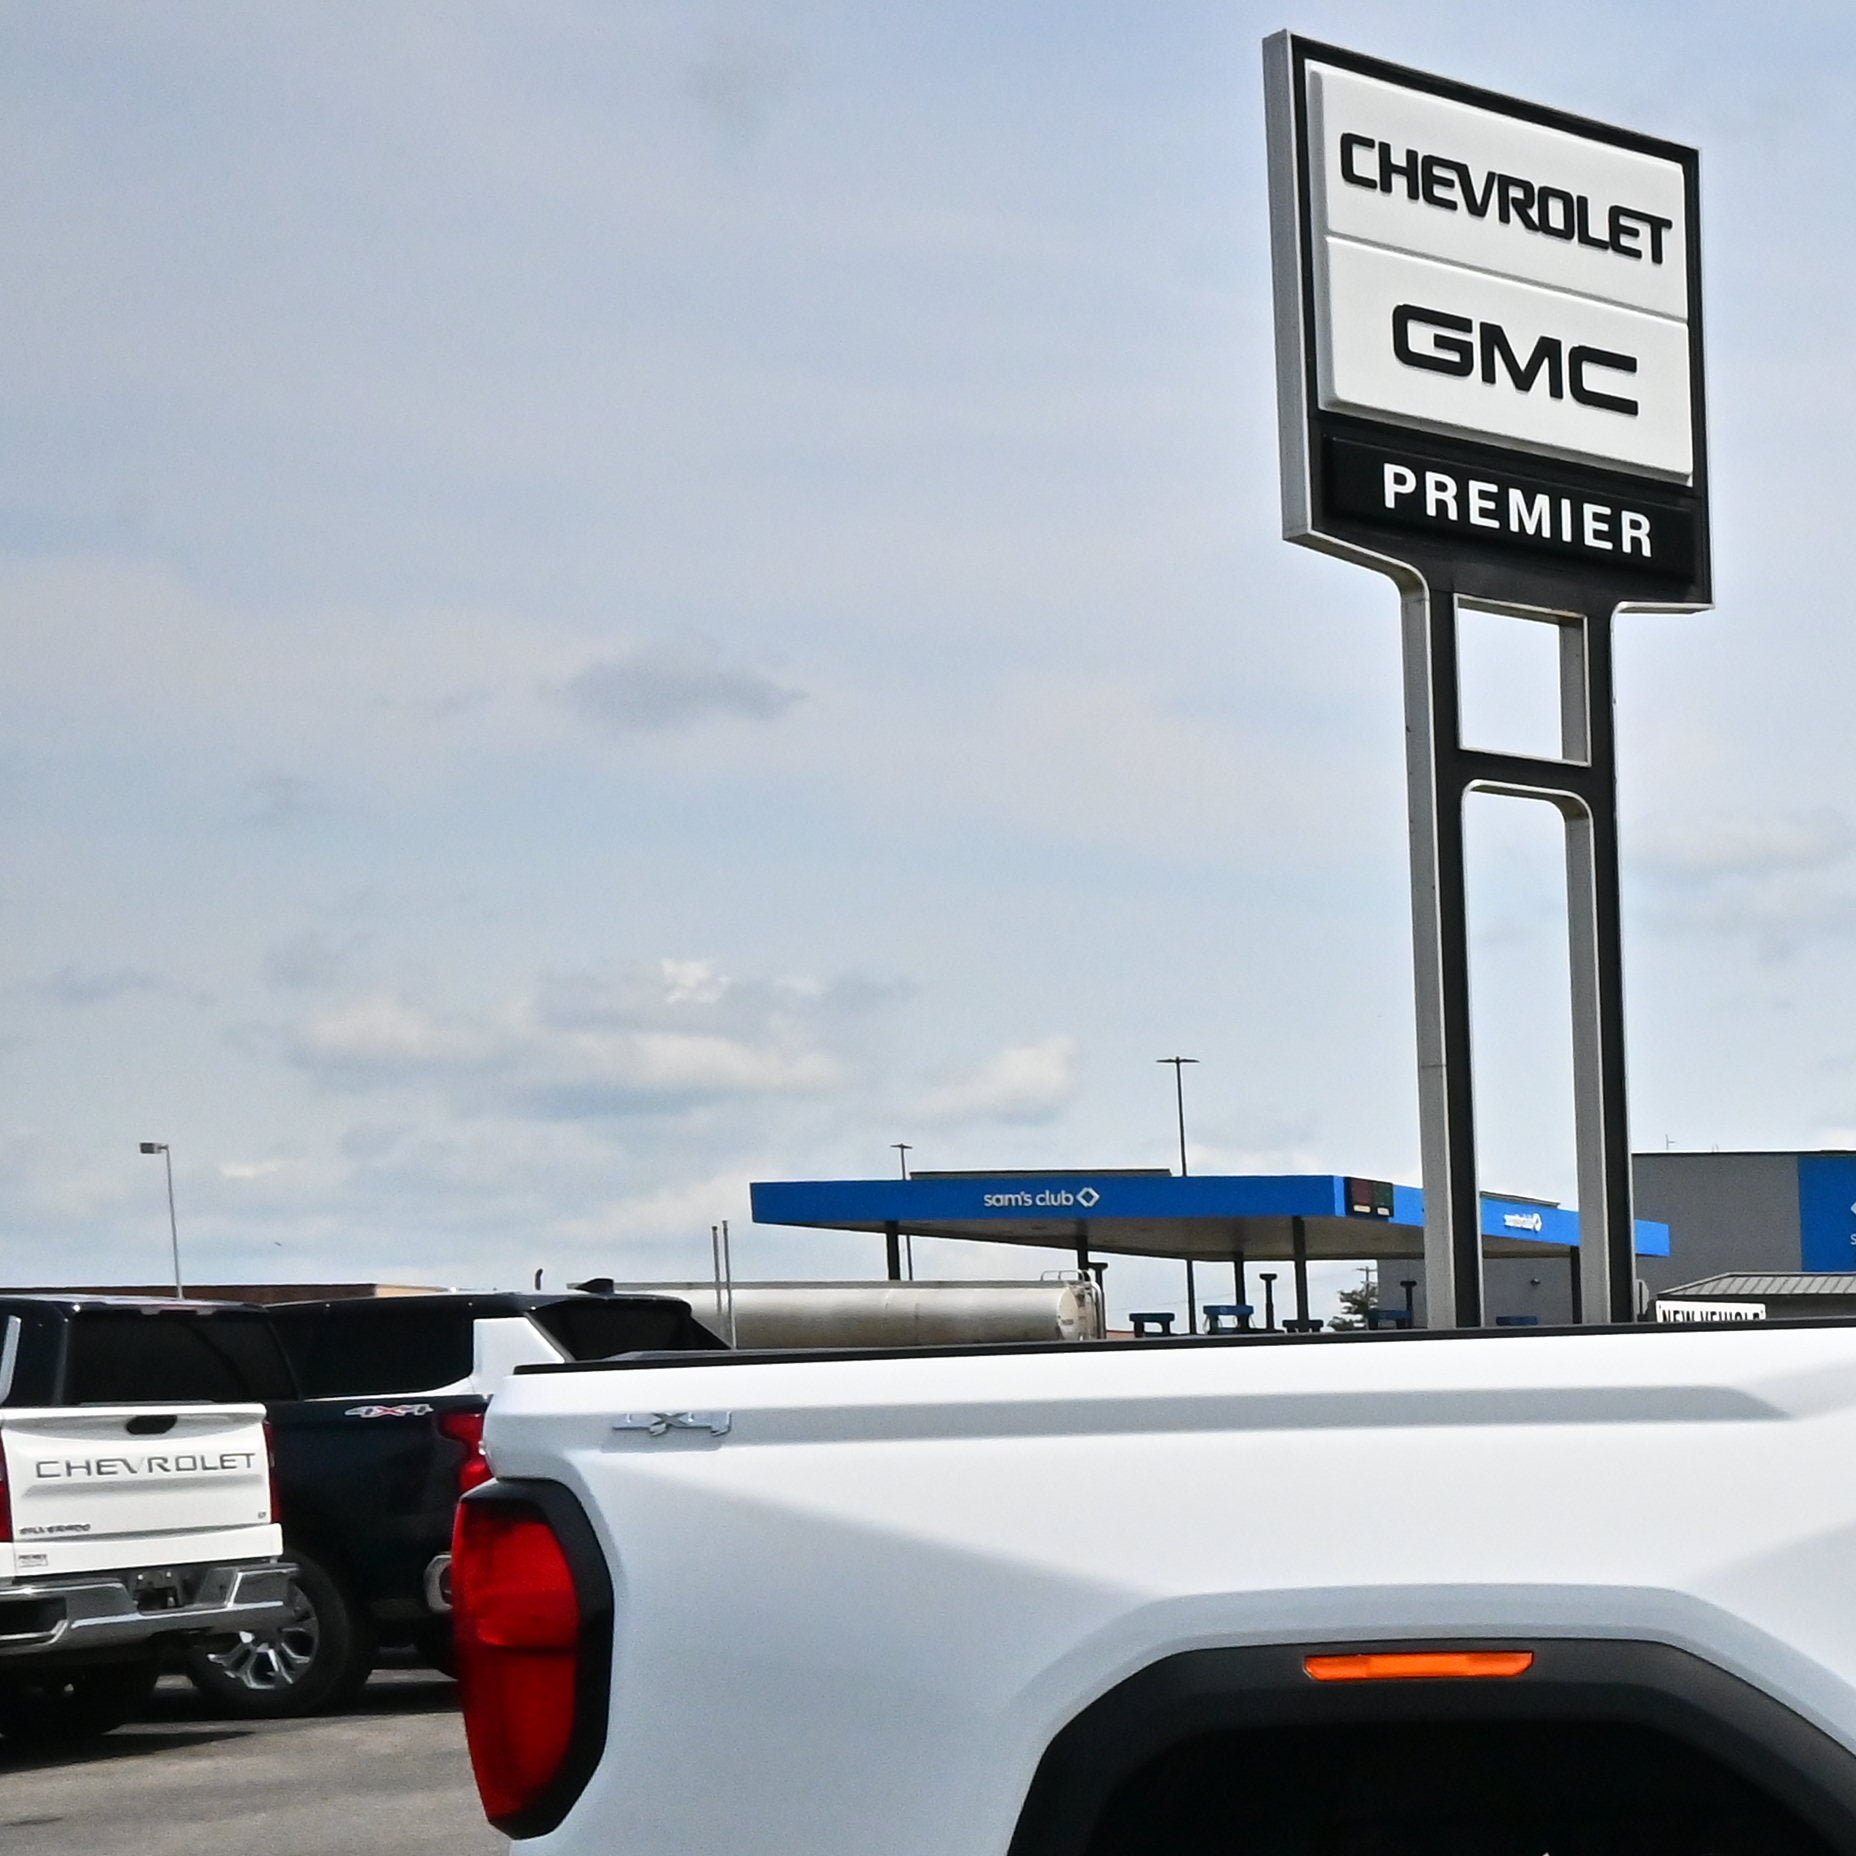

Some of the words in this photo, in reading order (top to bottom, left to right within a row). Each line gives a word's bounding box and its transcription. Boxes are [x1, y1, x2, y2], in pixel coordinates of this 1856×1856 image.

[1340, 132, 1673, 265] CHEVROLET
[1392, 303, 1639, 417] GMC
[1383, 462, 1653, 558] PREMIER
[983, 1191, 1033, 1207] sam's
[1035, 1189, 1074, 1206] club
[35, 1453, 255, 1479] CHEVROLET
